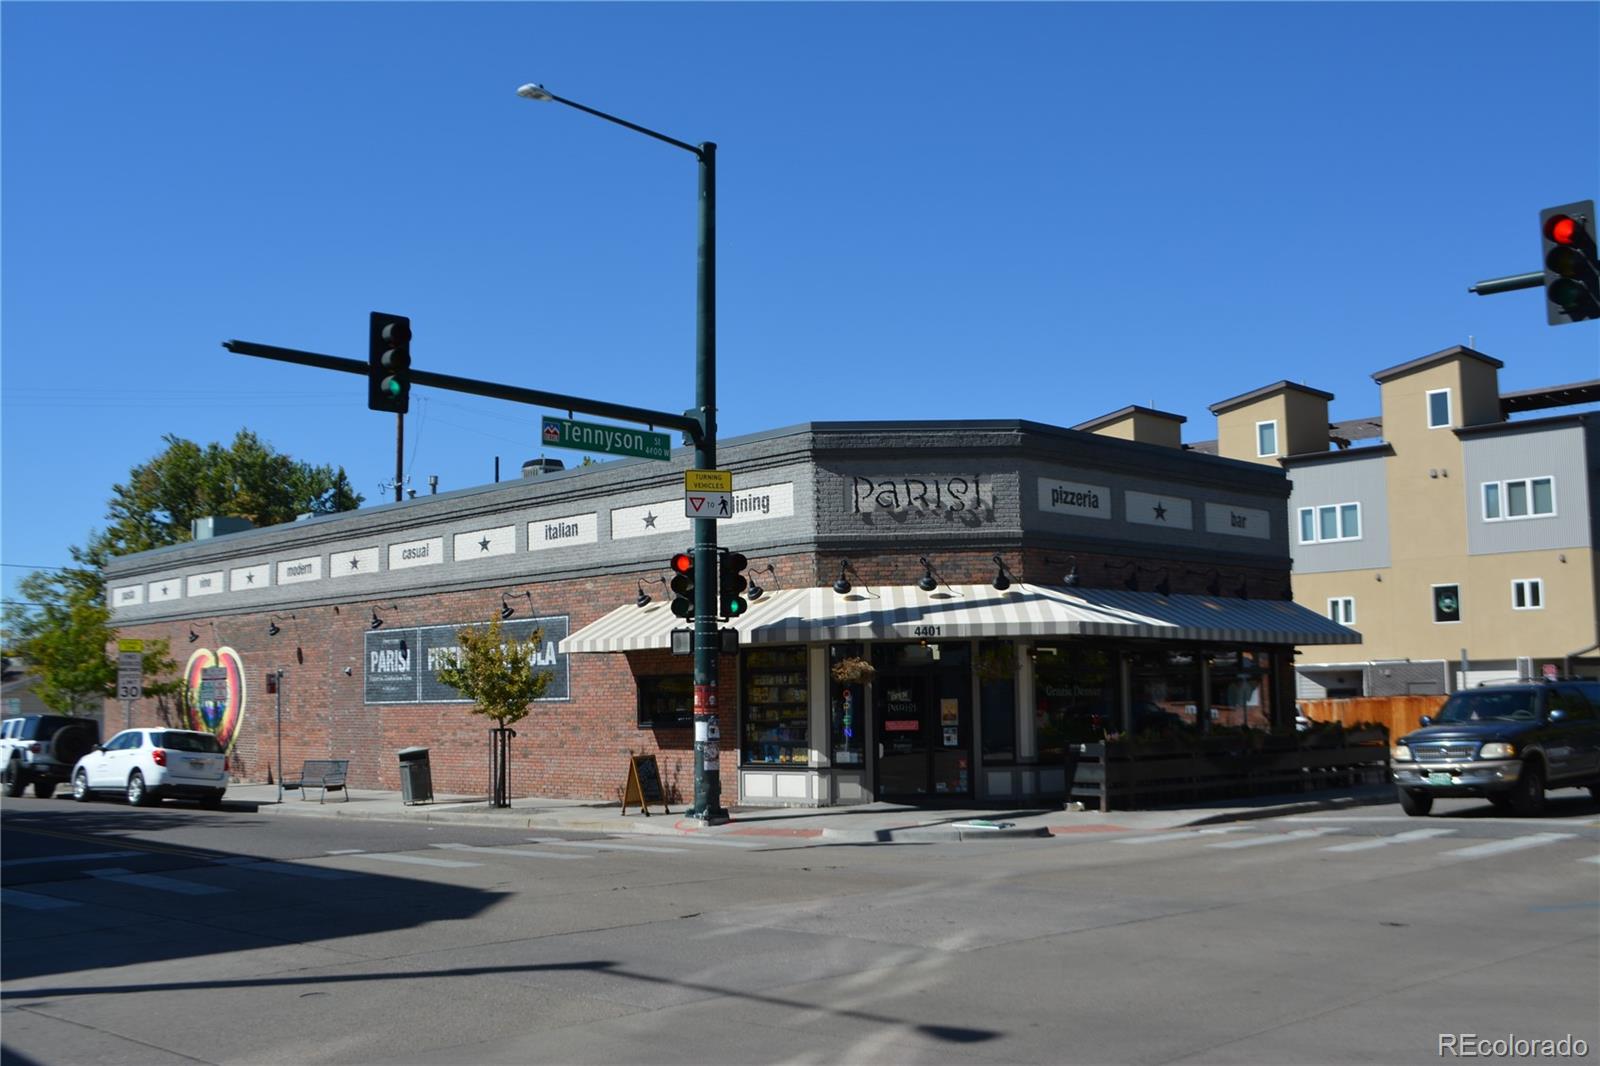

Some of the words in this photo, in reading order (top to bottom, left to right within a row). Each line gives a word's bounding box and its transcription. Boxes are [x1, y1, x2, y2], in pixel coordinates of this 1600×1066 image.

[563, 422, 643, 451] Tennyson
[693, 481, 725, 489] VEHICLES
[695, 473, 723, 481] TURNING
[707, 501, 715, 509] TO
[731, 494, 770, 514] ining
[1051, 486, 1100, 510] pizzeria
[1230, 511, 1247, 530] bar
[545, 522, 579, 541] italian
[402, 543, 430, 560] casual
[287, 562, 313, 577] modern
[914, 625, 941, 637] 4401
[370, 649, 411, 673] PARISI
[120, 686, 139, 697] 30
